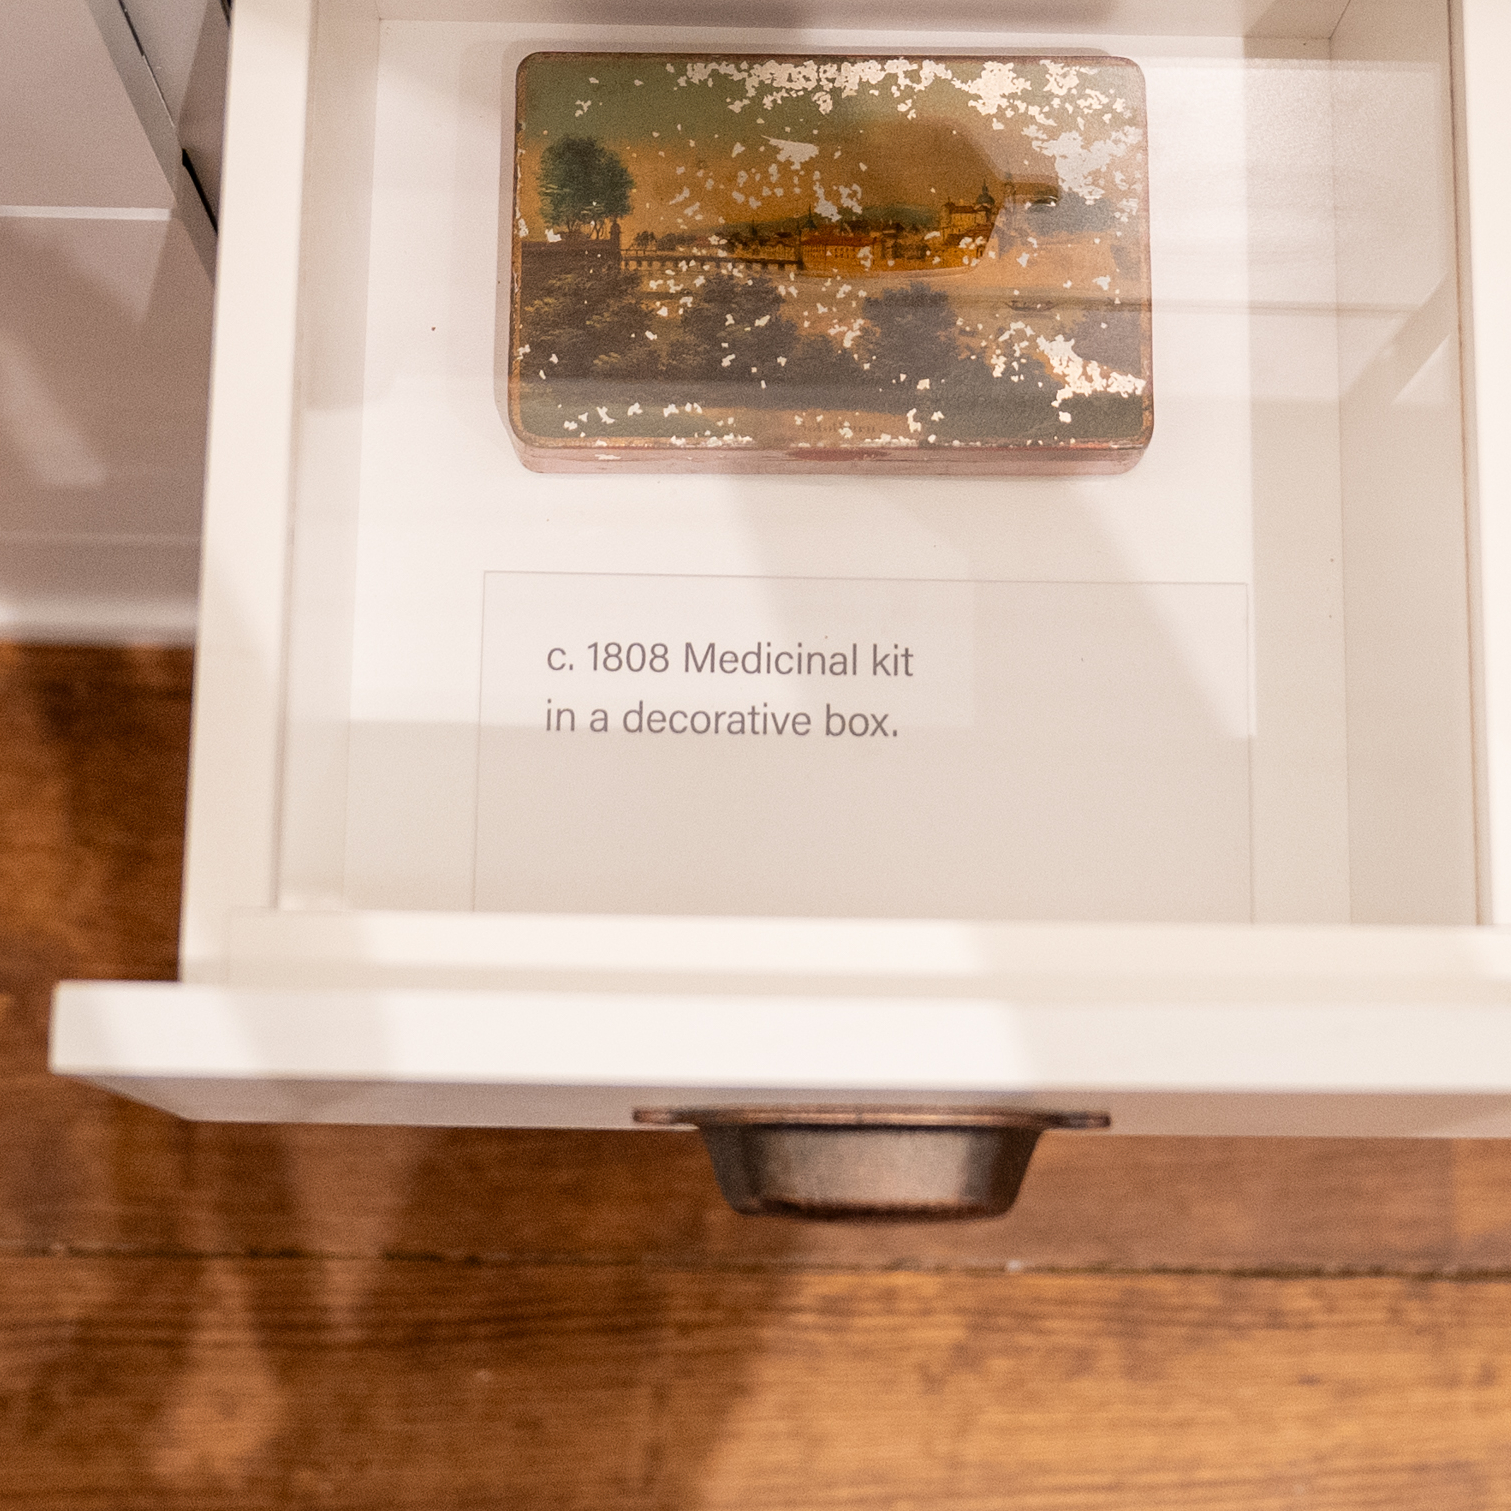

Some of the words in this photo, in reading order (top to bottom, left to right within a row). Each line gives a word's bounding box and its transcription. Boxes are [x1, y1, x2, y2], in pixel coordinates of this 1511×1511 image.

[547, 646, 575, 671] c.
[587, 642, 670, 673] 1808
[684, 641, 858, 676] Medicinal
[871, 643, 914, 677] kit
[545, 698, 576, 732] in
[589, 708, 609, 732] a
[622, 701, 812, 735] decorative
[824, 703, 898, 737] box.
